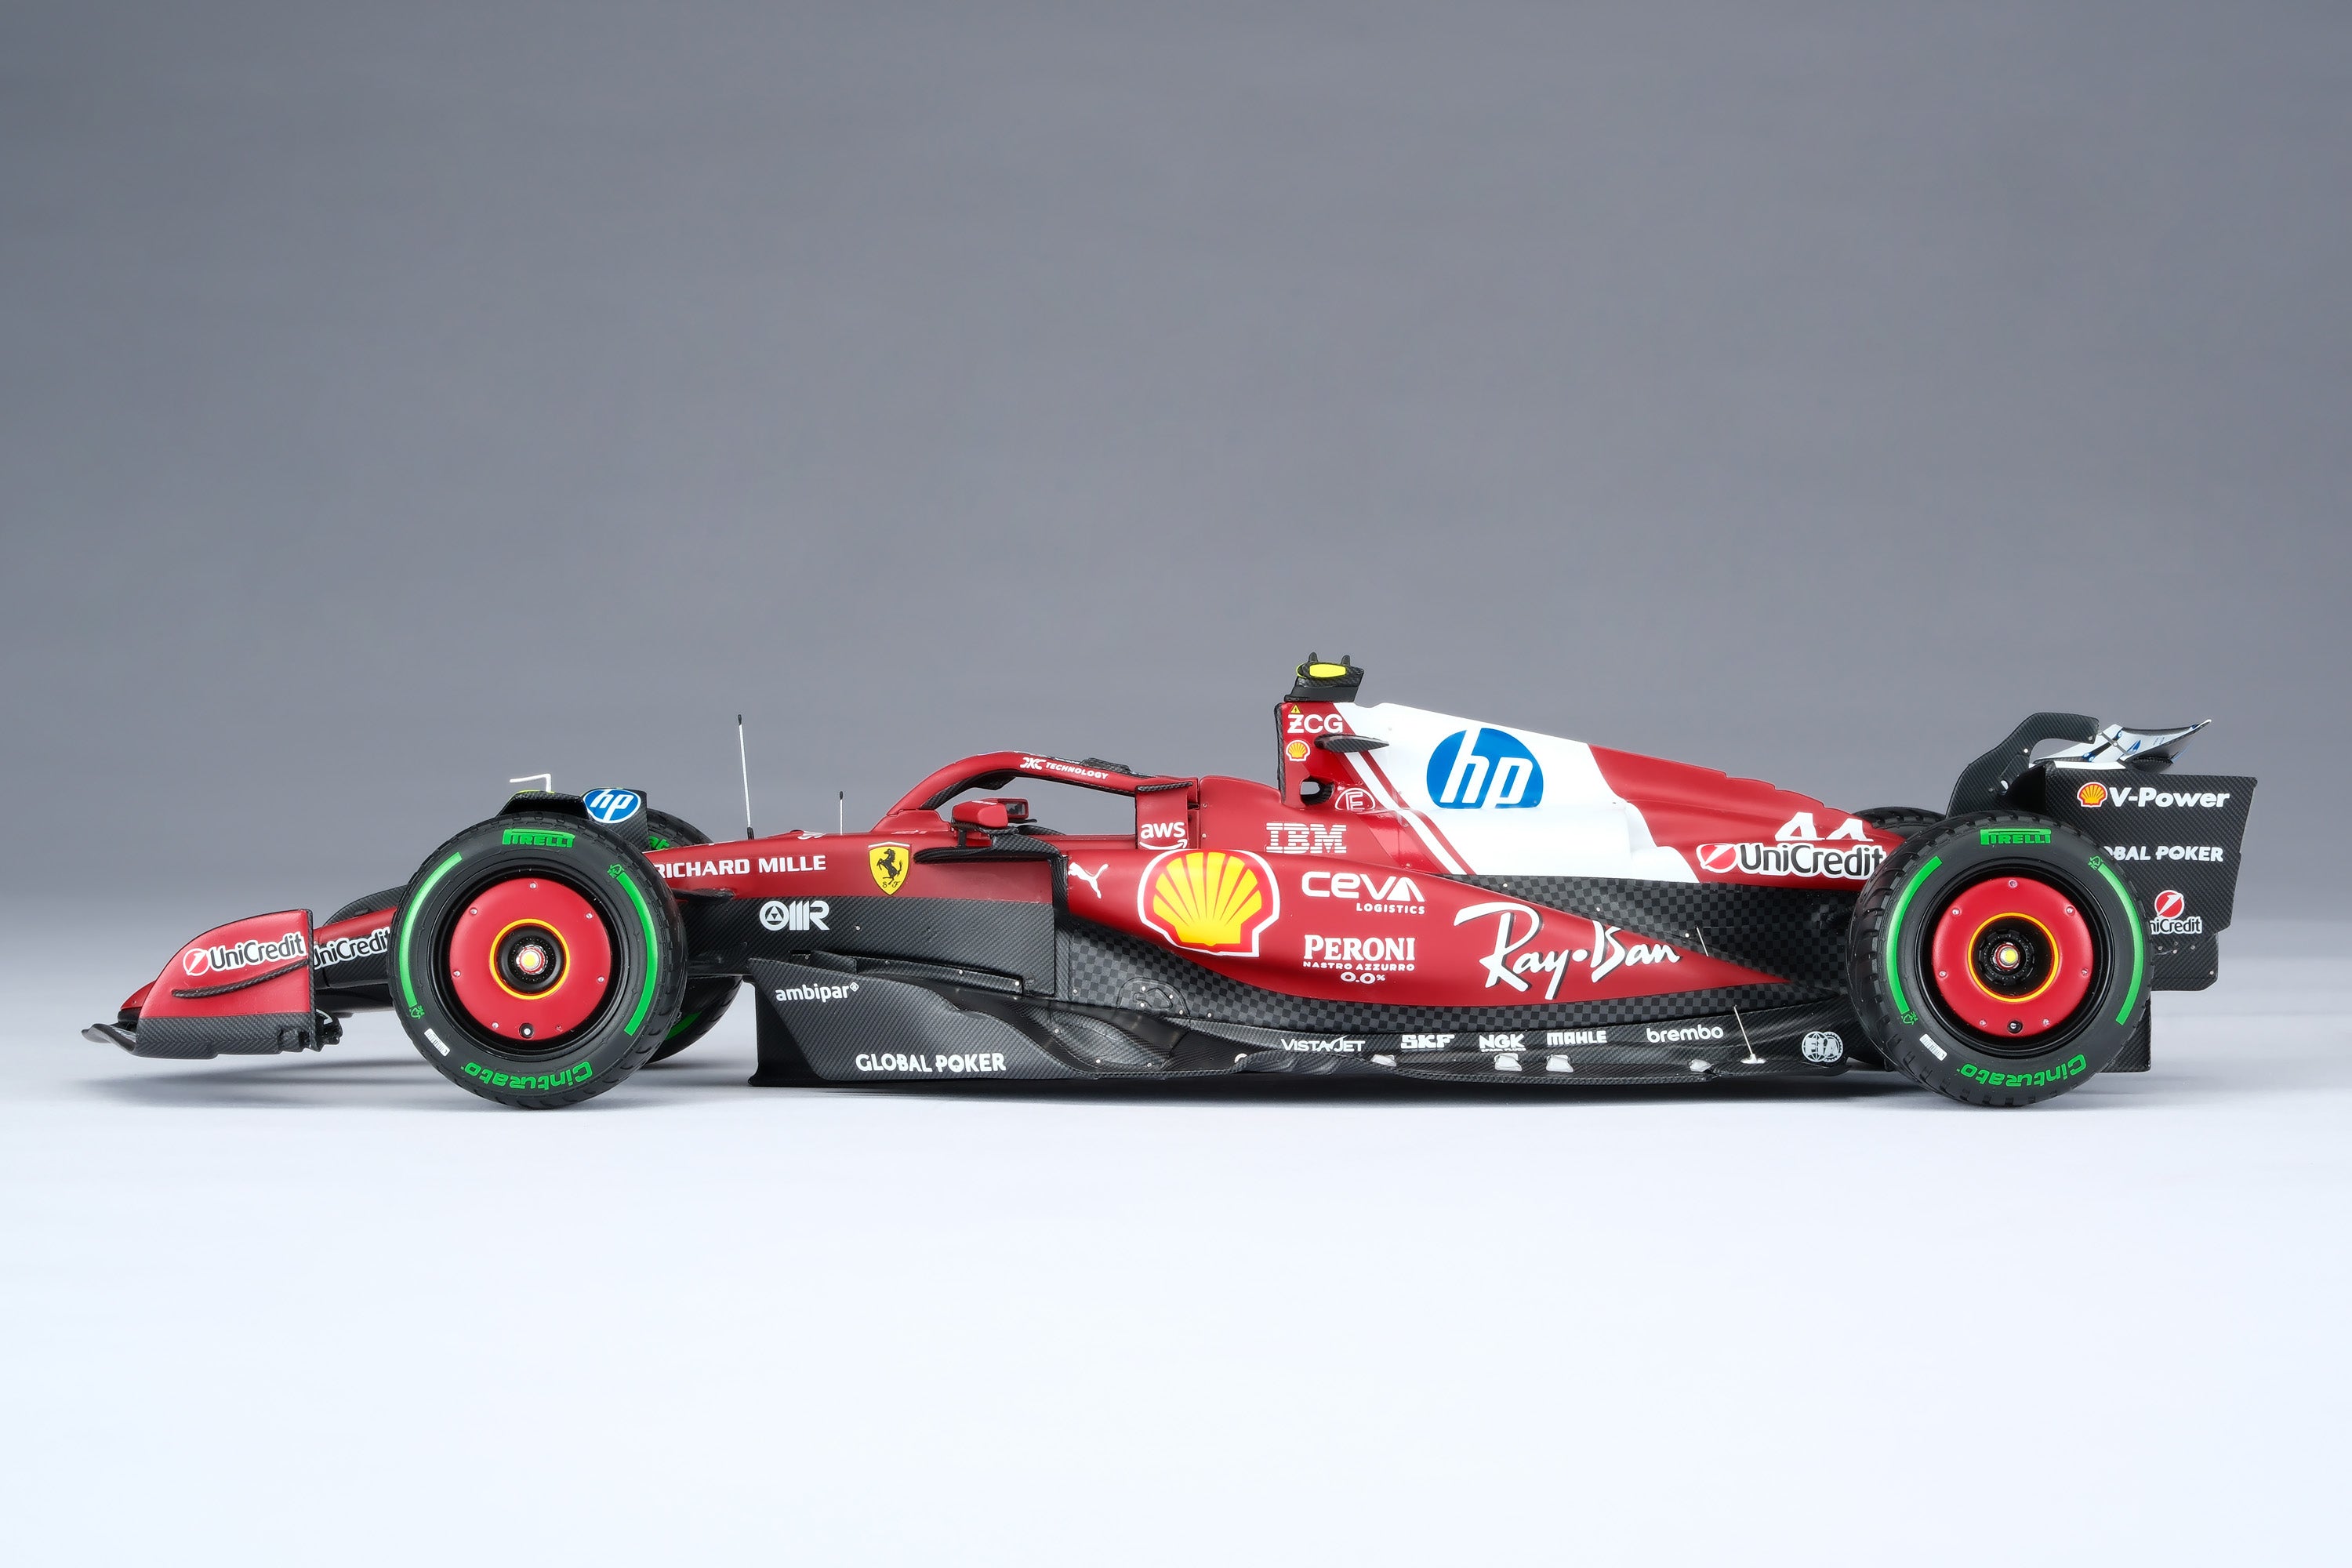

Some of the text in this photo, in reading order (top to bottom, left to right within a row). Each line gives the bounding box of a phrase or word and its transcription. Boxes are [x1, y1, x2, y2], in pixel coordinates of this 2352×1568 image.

[1046, 761, 1109, 780] TECHNOLOGY
[1439, 728, 1534, 809] hp
[590, 789, 634, 822] hp
[2108, 787, 2230, 808] V-Power
[502, 829, 575, 848] PIRELLI
[1140, 822, 1186, 839] aws
[1265, 822, 1347, 854] IBM
[1980, 828, 2052, 845] PIRELLI
[1740, 844, 1883, 877] UniCredit
[2103, 845, 2224, 862] BAL POKER
[654, 855, 826, 879] RICHARD MILLE
[1356, 902, 1425, 915] LOGISTICS
[2150, 918, 2201, 932] niCredit
[209, 933, 304, 969] UniCredit
[1303, 935, 1415, 961] PERONI
[1302, 961, 1415, 971] NASTRO AZZURRO
[775, 984, 850, 1003] ambipar
[1400, 1034, 1455, 1049] SKF
[1479, 1033, 1525, 1049] NGK
[1546, 1030, 1608, 1047] MAHLE
[1646, 1024, 1724, 1044] brembo
[1805, 1037, 1839, 1056] FIA
[855, 1053, 1007, 1073] GLOBAL POKER
